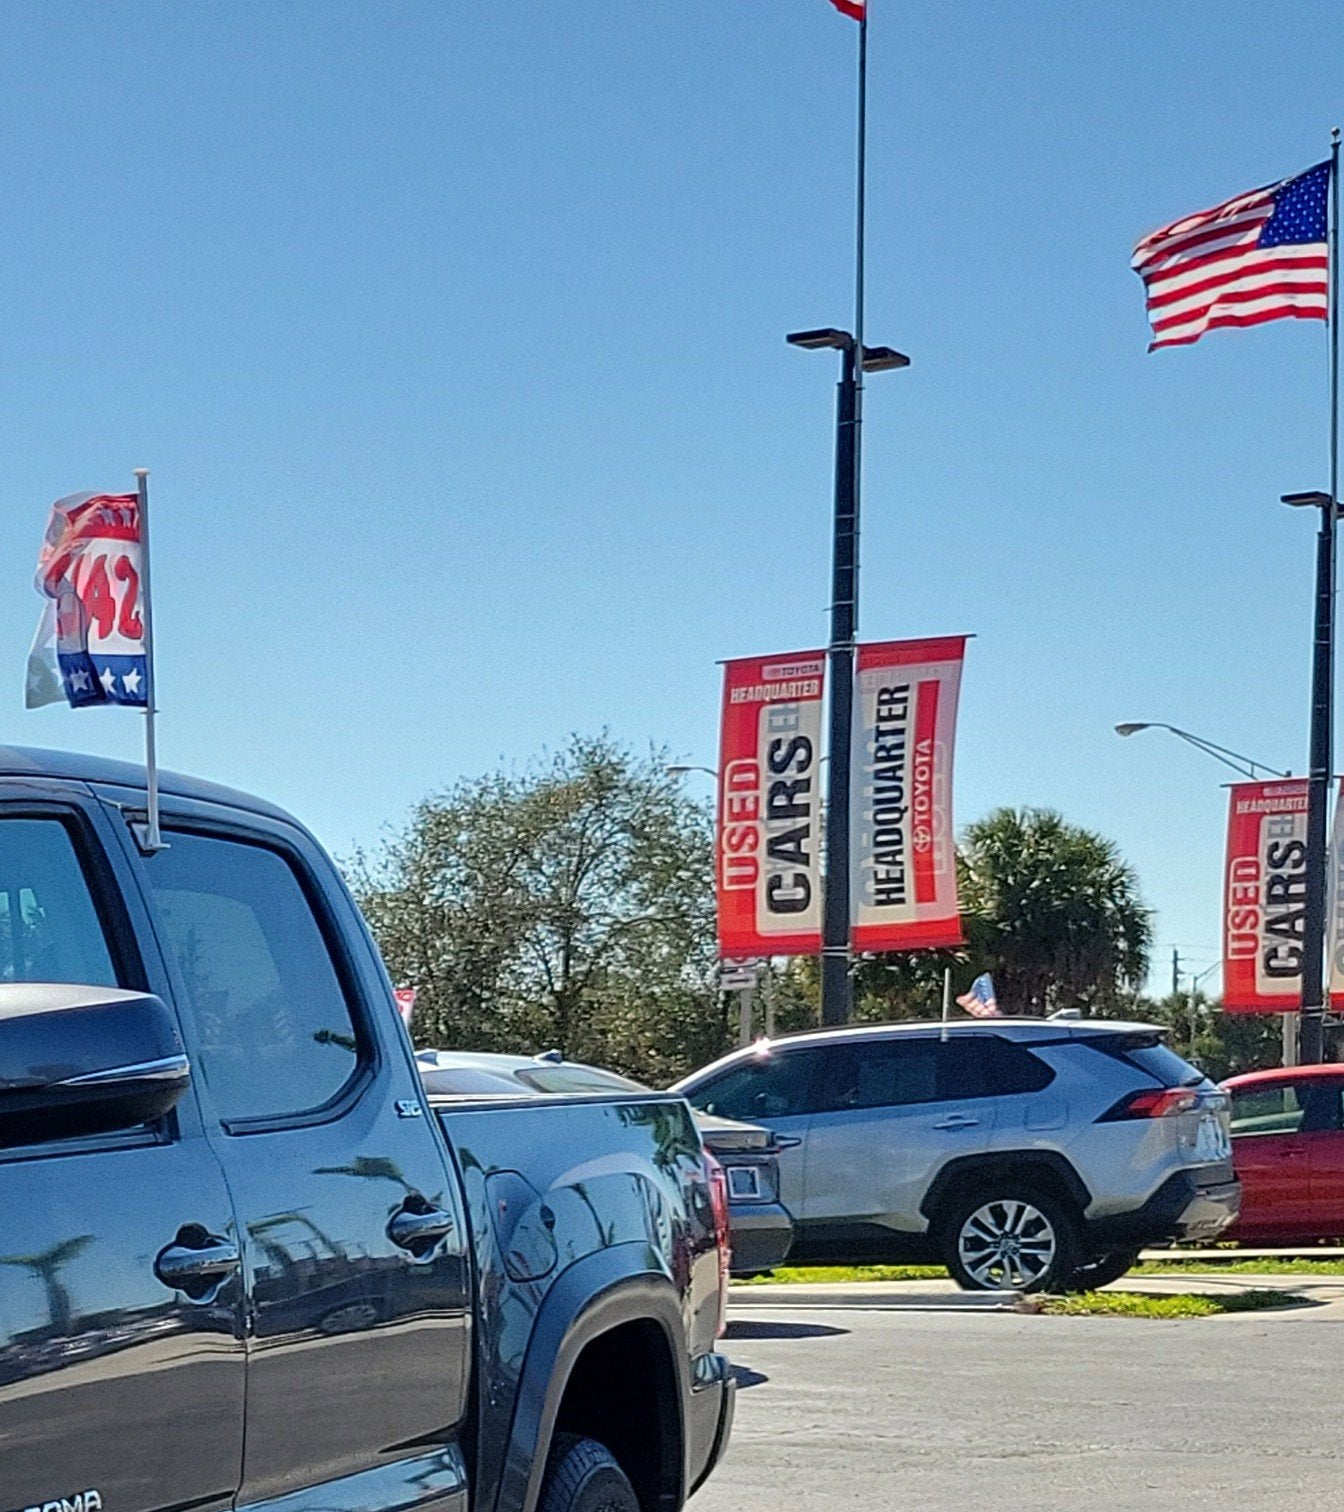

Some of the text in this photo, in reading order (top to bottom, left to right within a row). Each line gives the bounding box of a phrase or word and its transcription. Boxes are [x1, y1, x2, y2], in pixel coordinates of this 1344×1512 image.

[730, 680, 820, 703] HEADQUARTER
[723, 760, 759, 889] USED
[767, 736, 813, 915] CARS
[873, 683, 909, 907] HEADQUARTER
[914, 738, 932, 825] TOYOTA
[1229, 857, 1260, 959] USED
[1263, 840, 1307, 979] CARS
